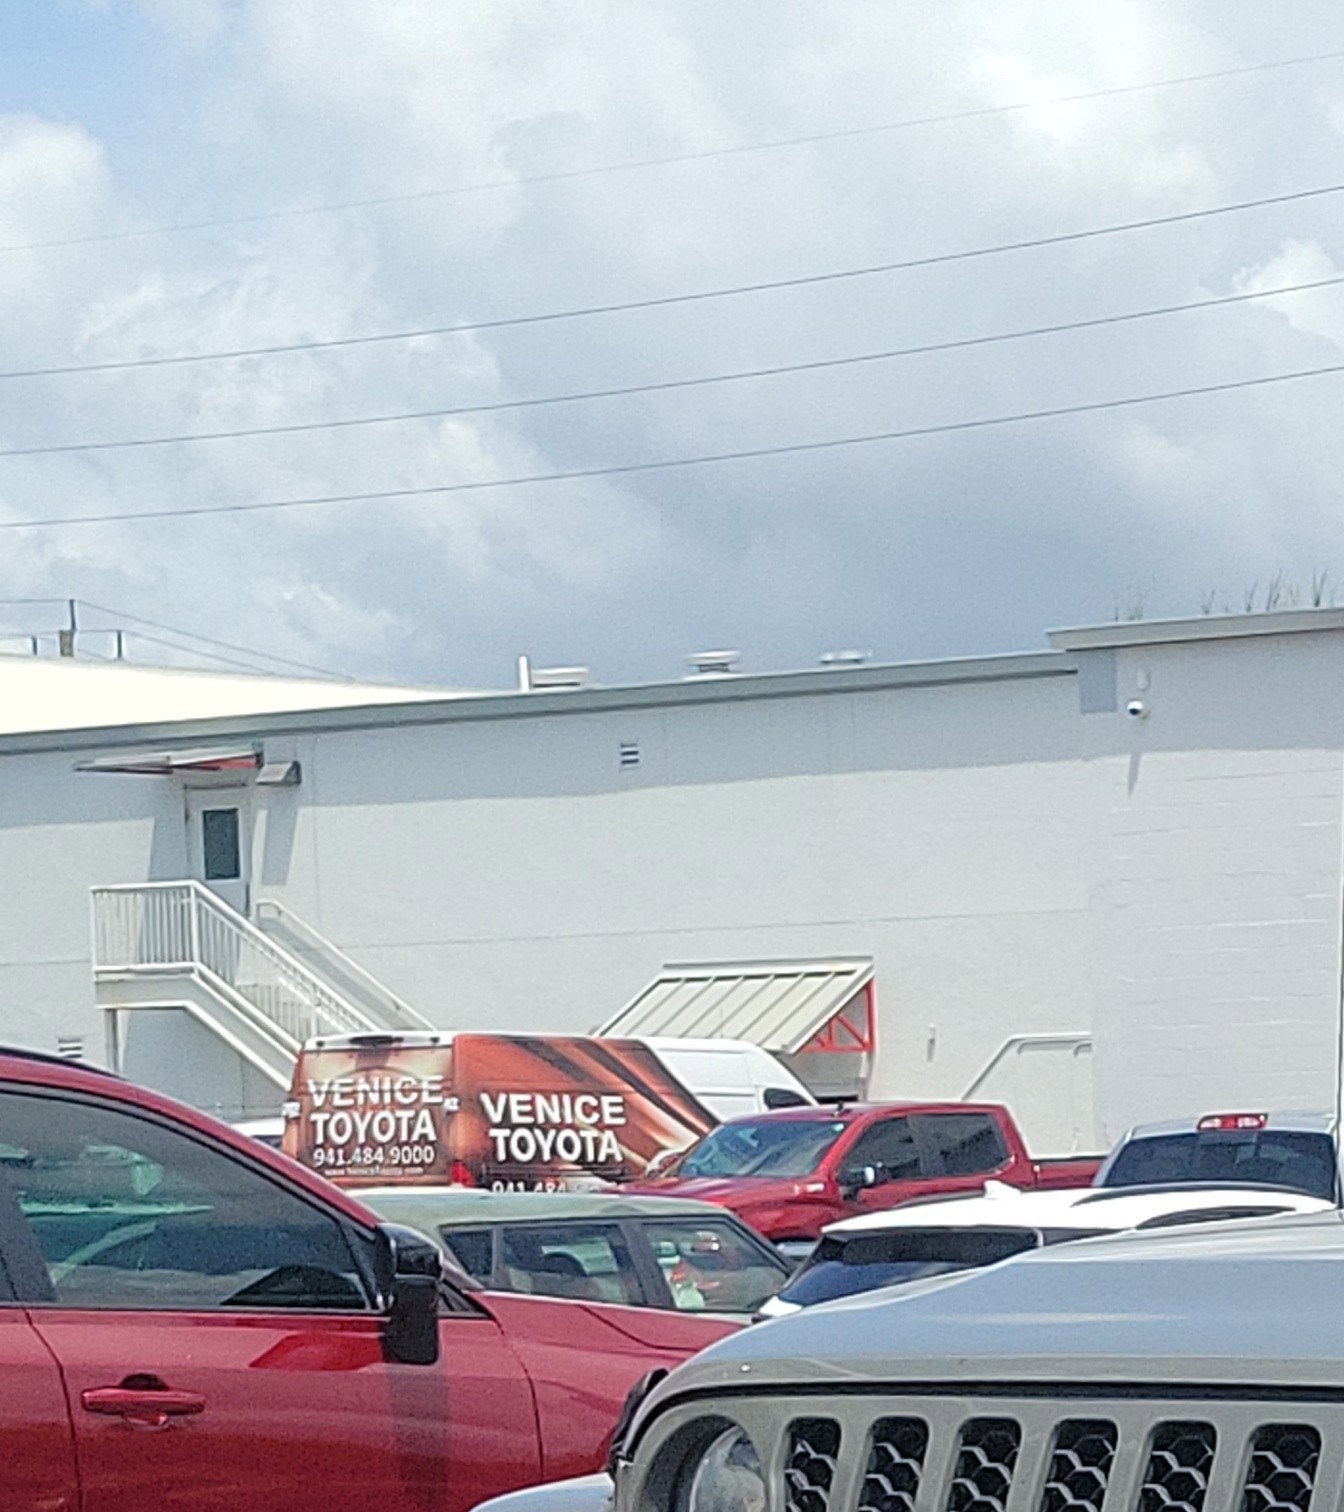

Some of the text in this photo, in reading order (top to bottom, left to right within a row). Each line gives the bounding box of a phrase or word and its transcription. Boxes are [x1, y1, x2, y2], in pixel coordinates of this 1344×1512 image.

[307, 1075, 444, 1107] VENICE
[480, 1092, 627, 1126] VENICE
[310, 1109, 438, 1146] TOYOTA
[312, 1145, 436, 1167] 941.484.9000
[488, 1127, 624, 1163] TOYOTA
